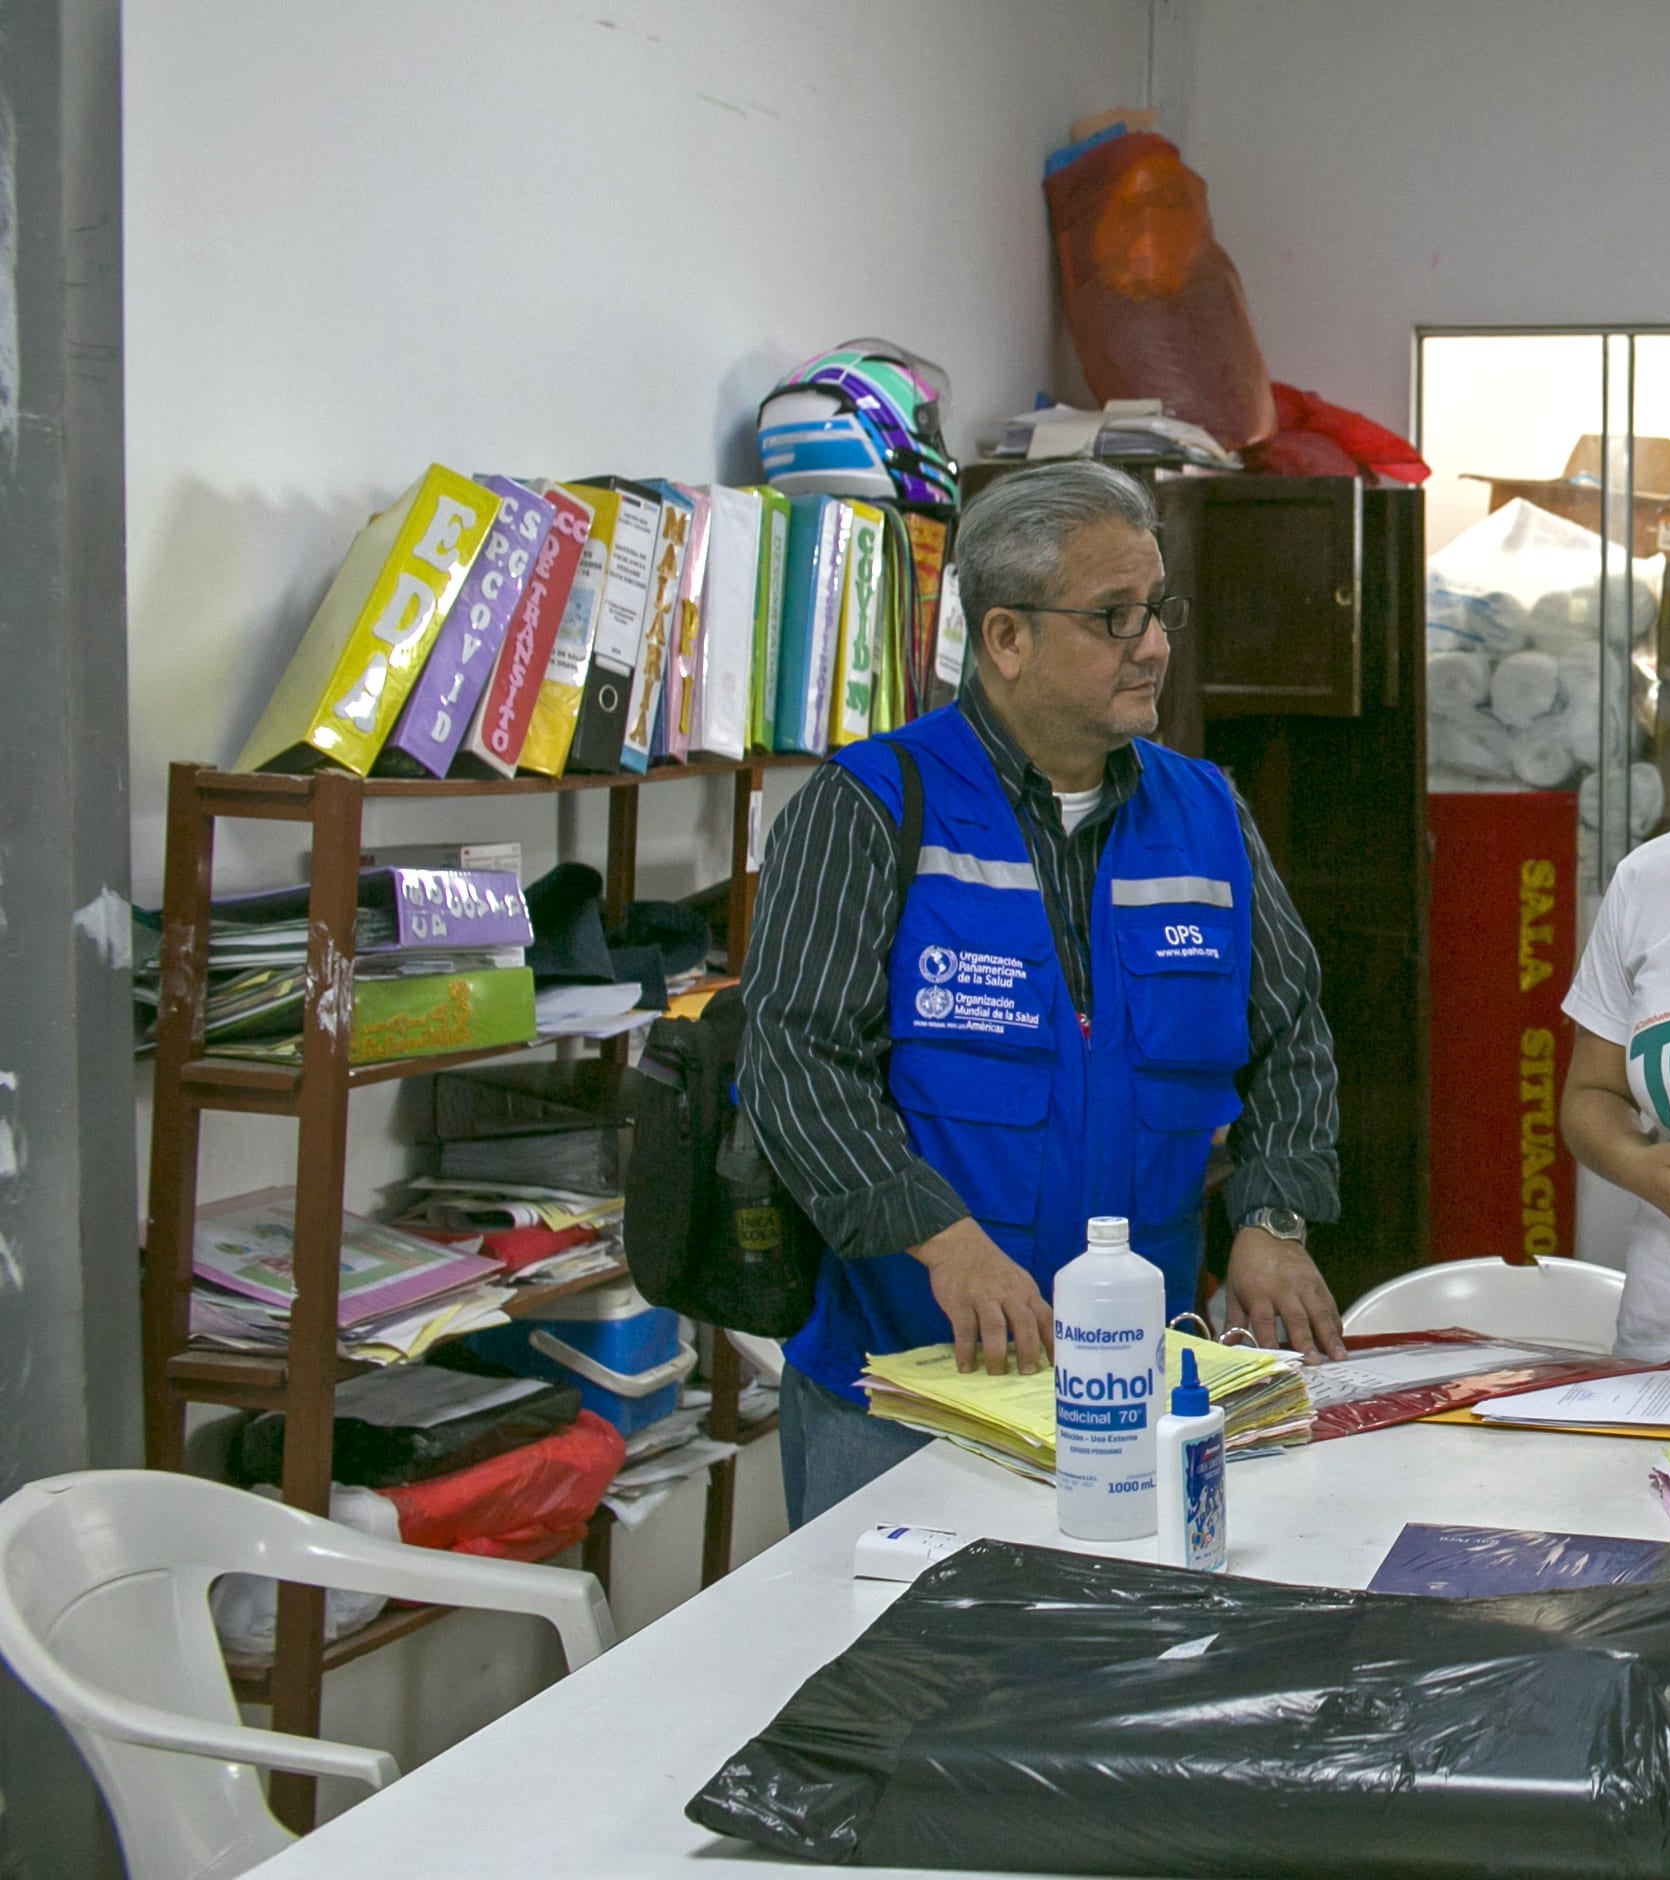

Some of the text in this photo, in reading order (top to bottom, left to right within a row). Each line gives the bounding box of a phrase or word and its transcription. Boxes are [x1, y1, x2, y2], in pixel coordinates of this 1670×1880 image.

[851, 526, 876, 671] COVID
[431, 575, 503, 743] COVID
[490, 583, 548, 753] TRANSITO
[1164, 924, 1204, 946] OPS
[1517, 858, 1556, 994] SALA
[959, 951, 1023, 968] Organización
[1155, 947, 1220, 959] www.paho.org
[958, 961, 1027, 979] Panamericana
[957, 973, 1014, 988] de la Salud
[955, 992, 1016, 1009] Organización
[954, 1005, 1040, 1025] Mundial de la Salud
[966, 1020, 1005, 1034] Américas
[1064, 1325, 1145, 1344] Alkofarma
[1054, 1364, 1154, 1401] Alcohol
[1090, 1435, 1106, 1443] Uso
[1107, 1434, 1139, 1443] Externo
[1108, 1481, 1140, 1494] 1000
